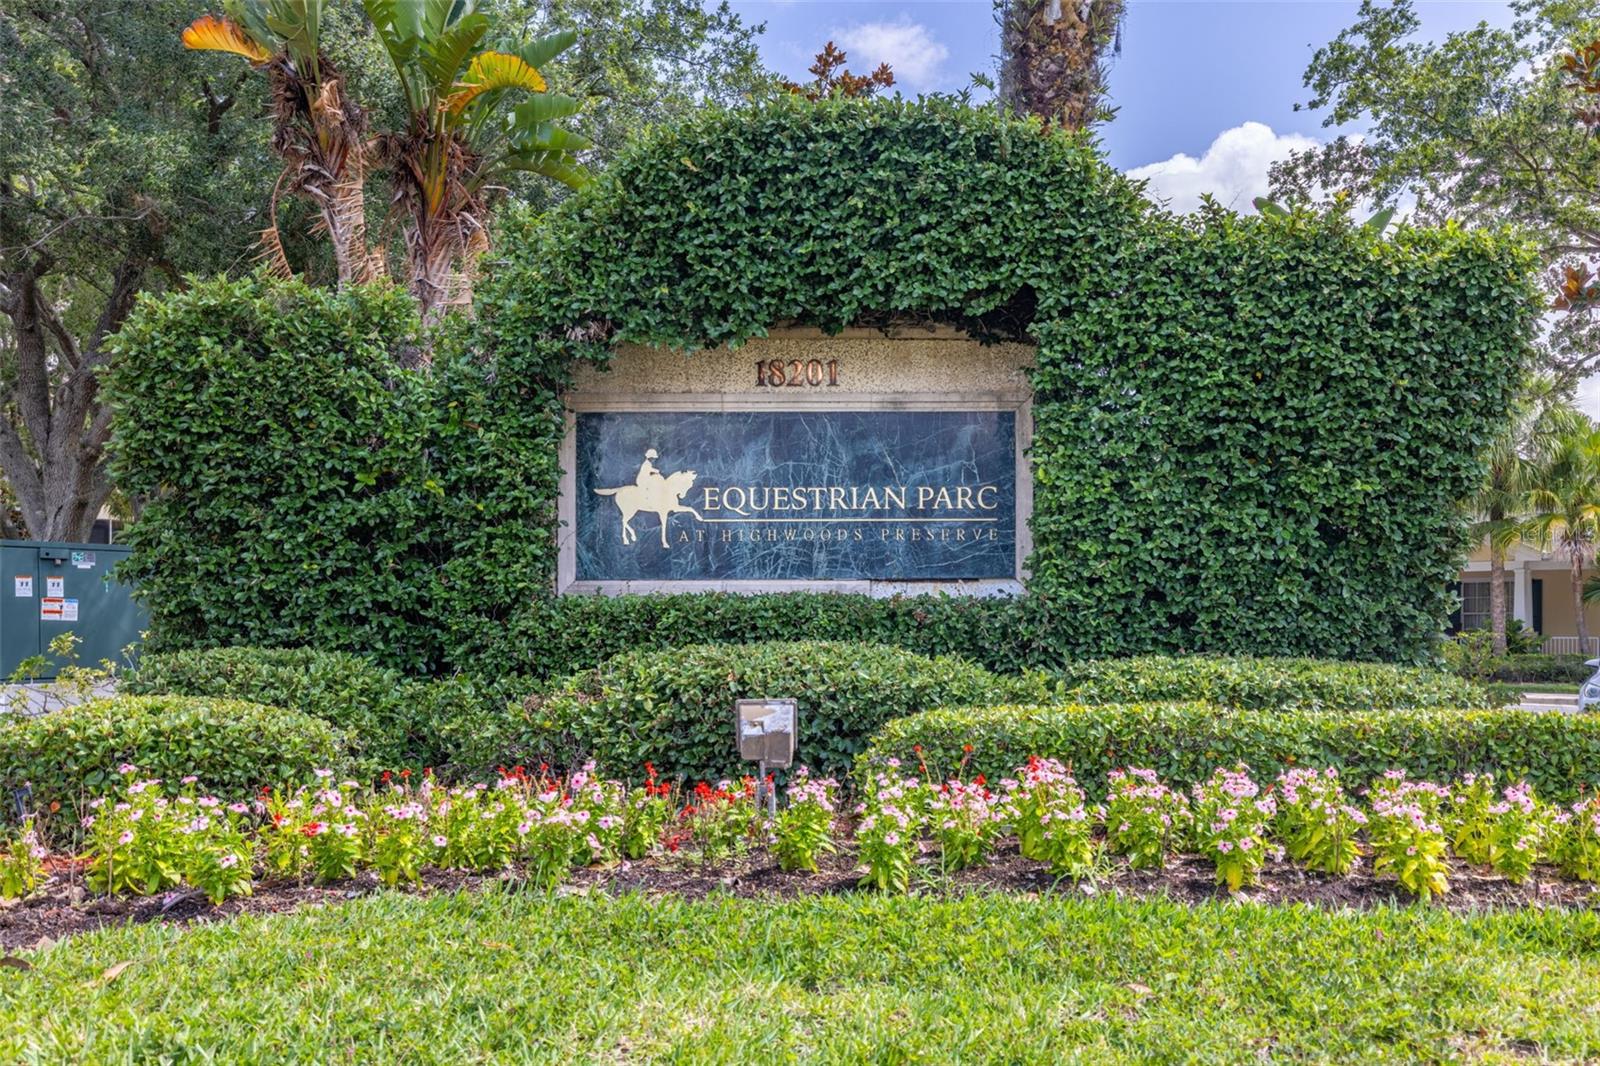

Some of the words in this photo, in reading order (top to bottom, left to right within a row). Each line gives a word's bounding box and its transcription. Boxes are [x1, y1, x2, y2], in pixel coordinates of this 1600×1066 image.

[756, 360, 839, 387] 18201
[704, 487, 906, 515] EQUESTRIAN
[917, 487, 998, 510] PARC
[679, 529, 705, 542] AT
[722, 529, 863, 542] HIGHWOODS
[882, 528, 998, 541] PRESERVE
